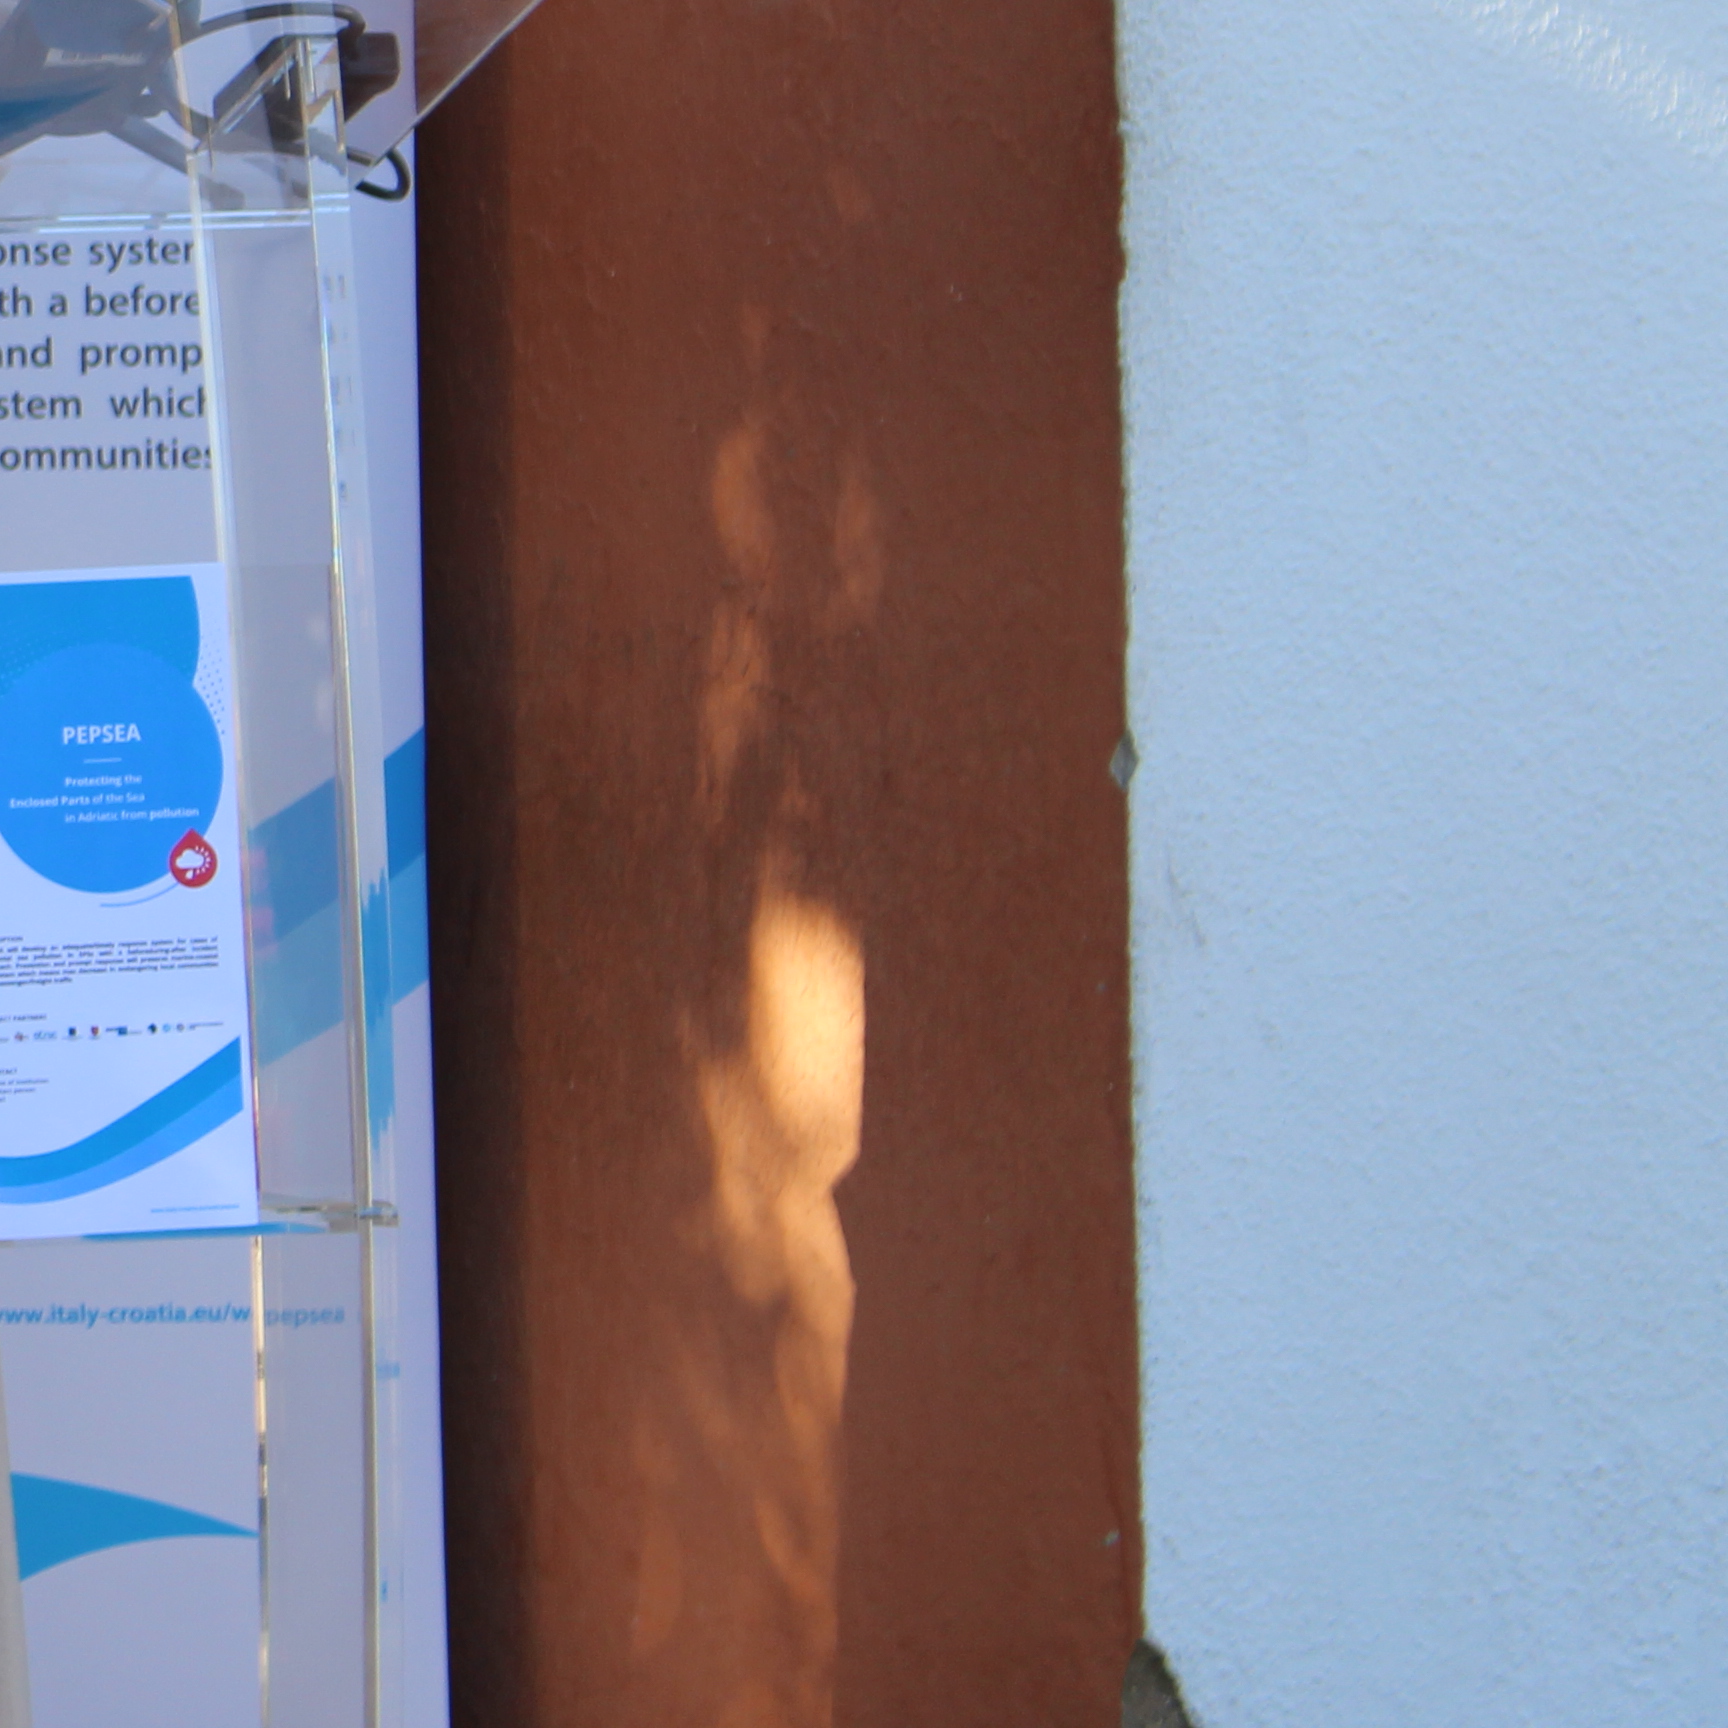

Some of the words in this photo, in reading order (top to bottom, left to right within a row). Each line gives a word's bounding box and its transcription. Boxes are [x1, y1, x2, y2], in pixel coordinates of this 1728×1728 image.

[49, 293, 68, 318] a
[62, 723, 142, 745] PEPSEA
[65, 775, 123, 788] Protecting
[124, 774, 142, 784] the
[9, 796, 59, 809] Enclosed
[61, 795, 90, 807] Parts
[92, 793, 104, 804] of
[106, 792, 124, 804] the
[126, 792, 146, 803] Sea
[65, 813, 77, 823] in
[79, 811, 118, 823] Adriatic
[121, 809, 148, 820] from
[150, 807, 200, 821] pollution
